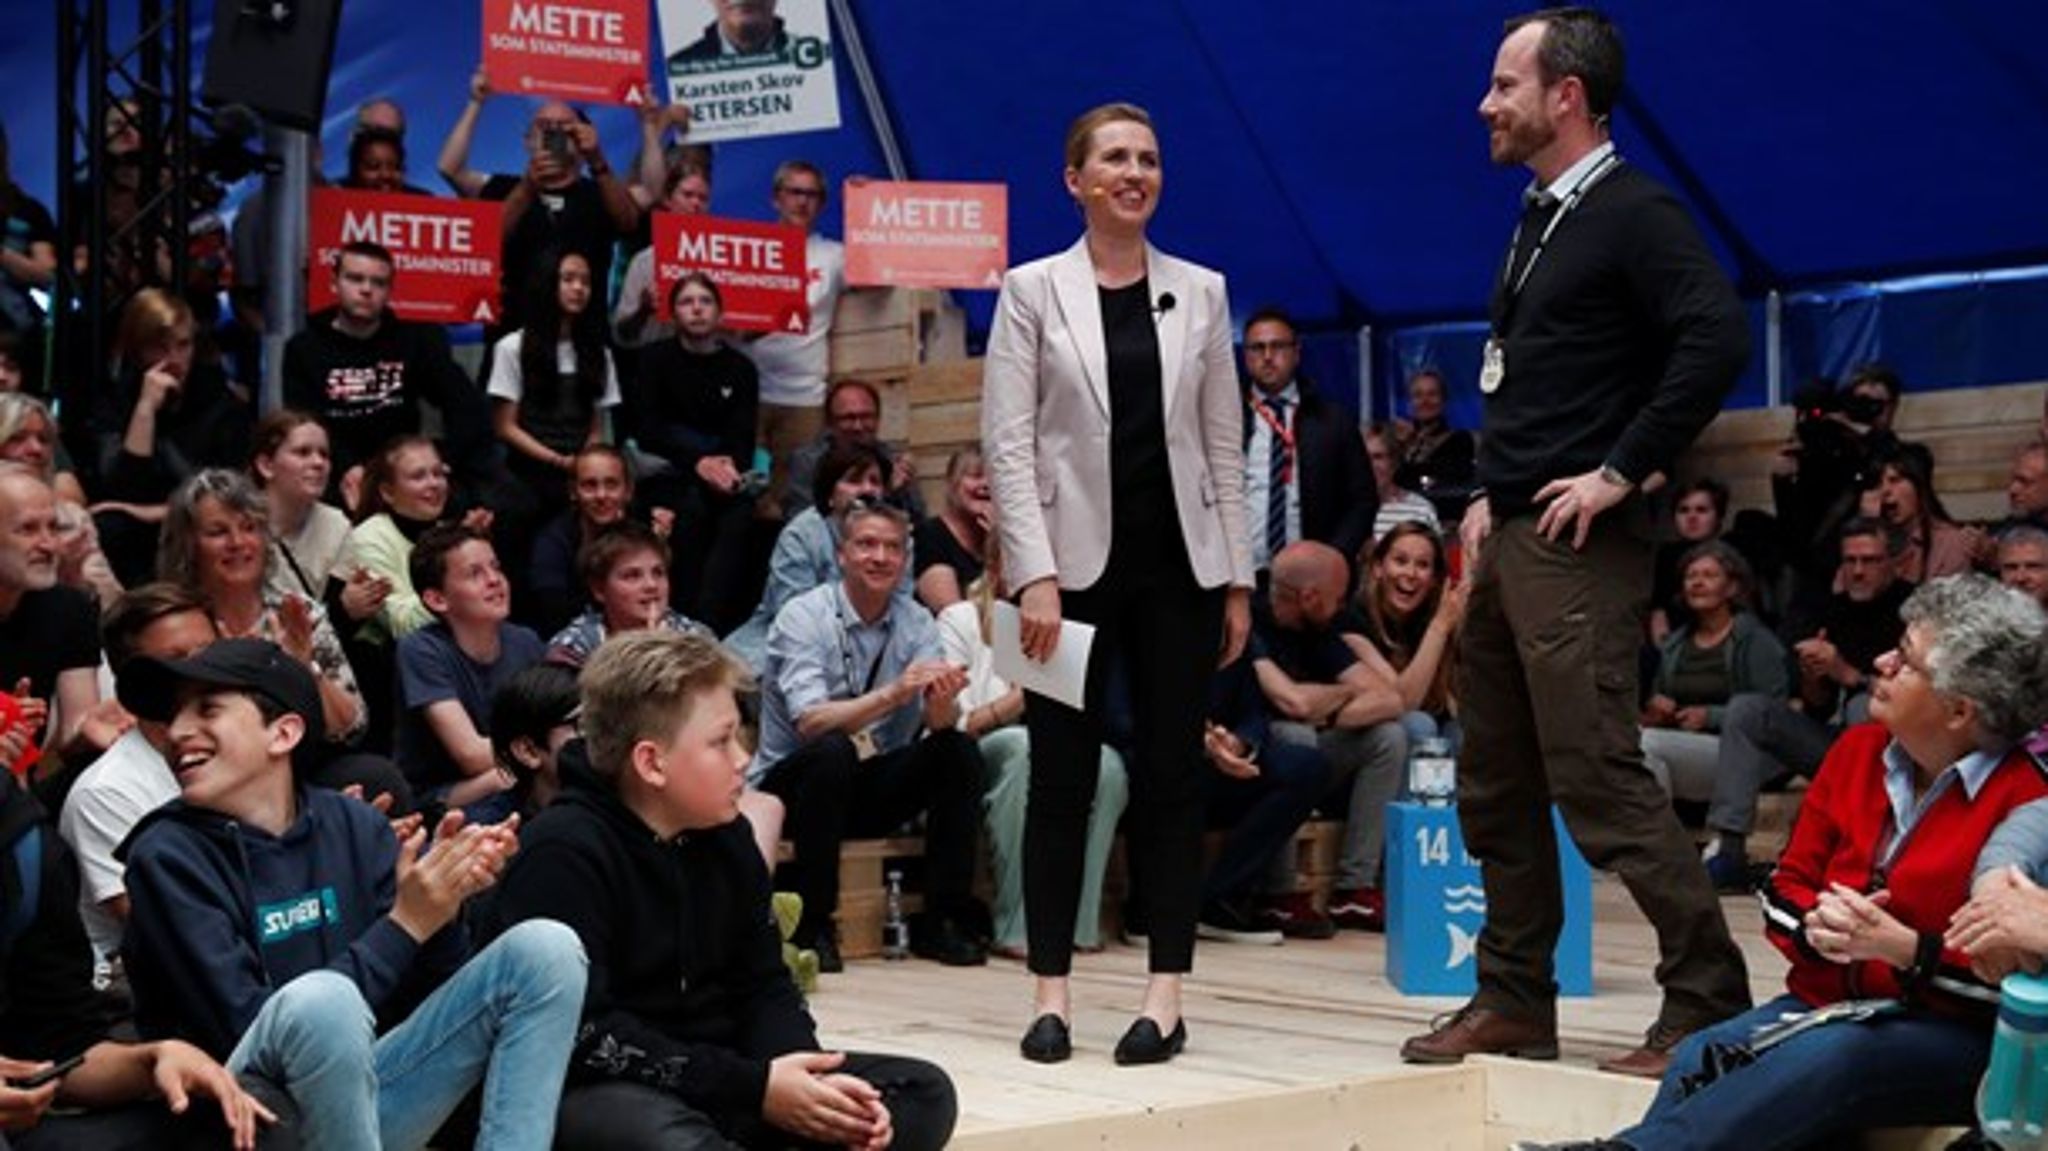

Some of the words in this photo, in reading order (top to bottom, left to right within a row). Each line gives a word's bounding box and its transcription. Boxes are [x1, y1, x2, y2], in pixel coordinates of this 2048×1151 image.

[509, 2, 624, 43] METTE
[489, 33, 526, 50] SOM
[529, 37, 642, 64] STATSMINISTER
[797, 40, 816, 61] C
[624, 85, 643, 104] A
[675, 79, 753, 98] Karsten
[757, 72, 805, 91] Skov
[693, 94, 792, 121] ETERSEN
[870, 196, 982, 230] METTE
[341, 210, 472, 252] METTE
[851, 229, 887, 244] SOM
[318, 247, 341, 266] SO
[677, 229, 784, 270] METTE
[473, 299, 495, 321] A
[787, 311, 804, 330] A
[1416, 827, 1451, 867] 14
